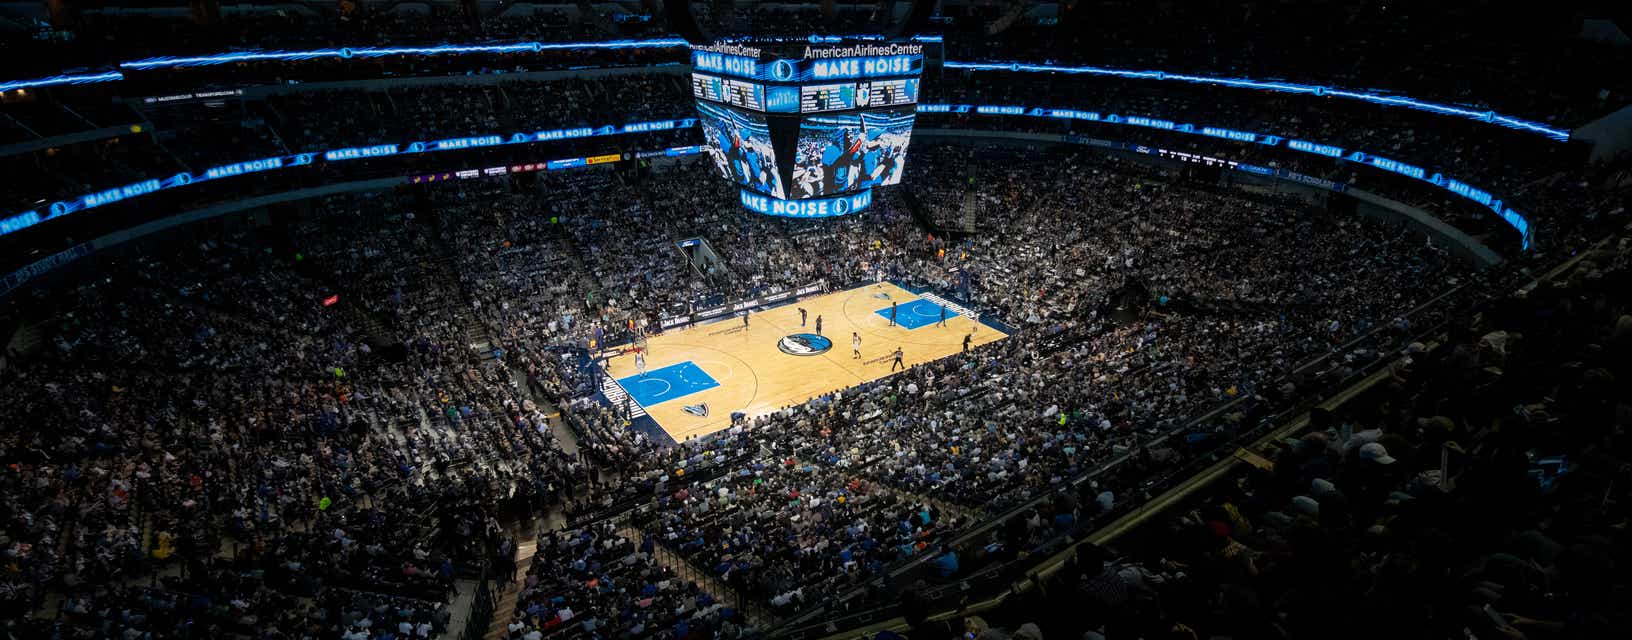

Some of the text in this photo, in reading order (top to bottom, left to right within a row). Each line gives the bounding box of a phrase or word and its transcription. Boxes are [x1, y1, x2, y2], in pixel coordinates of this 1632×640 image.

[804, 44, 922, 59] AmericanAirlinesCenter
[696, 54, 755, 75] MAKE NOISE
[813, 57, 909, 77] MAKE NOISE
[927, 105, 950, 113] NOISE
[976, 105, 1023, 116] MAKE NOISE
[1051, 109, 1100, 121] MAKE NOISE
[624, 120, 674, 134] MAKE NOISE
[1127, 116, 1175, 130] MAKE NOISE
[537, 126, 593, 141] MAKE NOISE
[1203, 126, 1255, 142] MAKE NOISE
[437, 135, 502, 150] MAKE NOISE
[1288, 140, 1342, 159] MAKE NOISE
[326, 143, 397, 161] MAKE NOISE
[207, 157, 282, 180] MAKE NOISE
[1373, 157, 1424, 179] MAKE NOISE
[84, 178, 161, 207] MAKE NOISE
[772, 201, 828, 217] NOISE
[1, 209, 38, 236] NOISE
